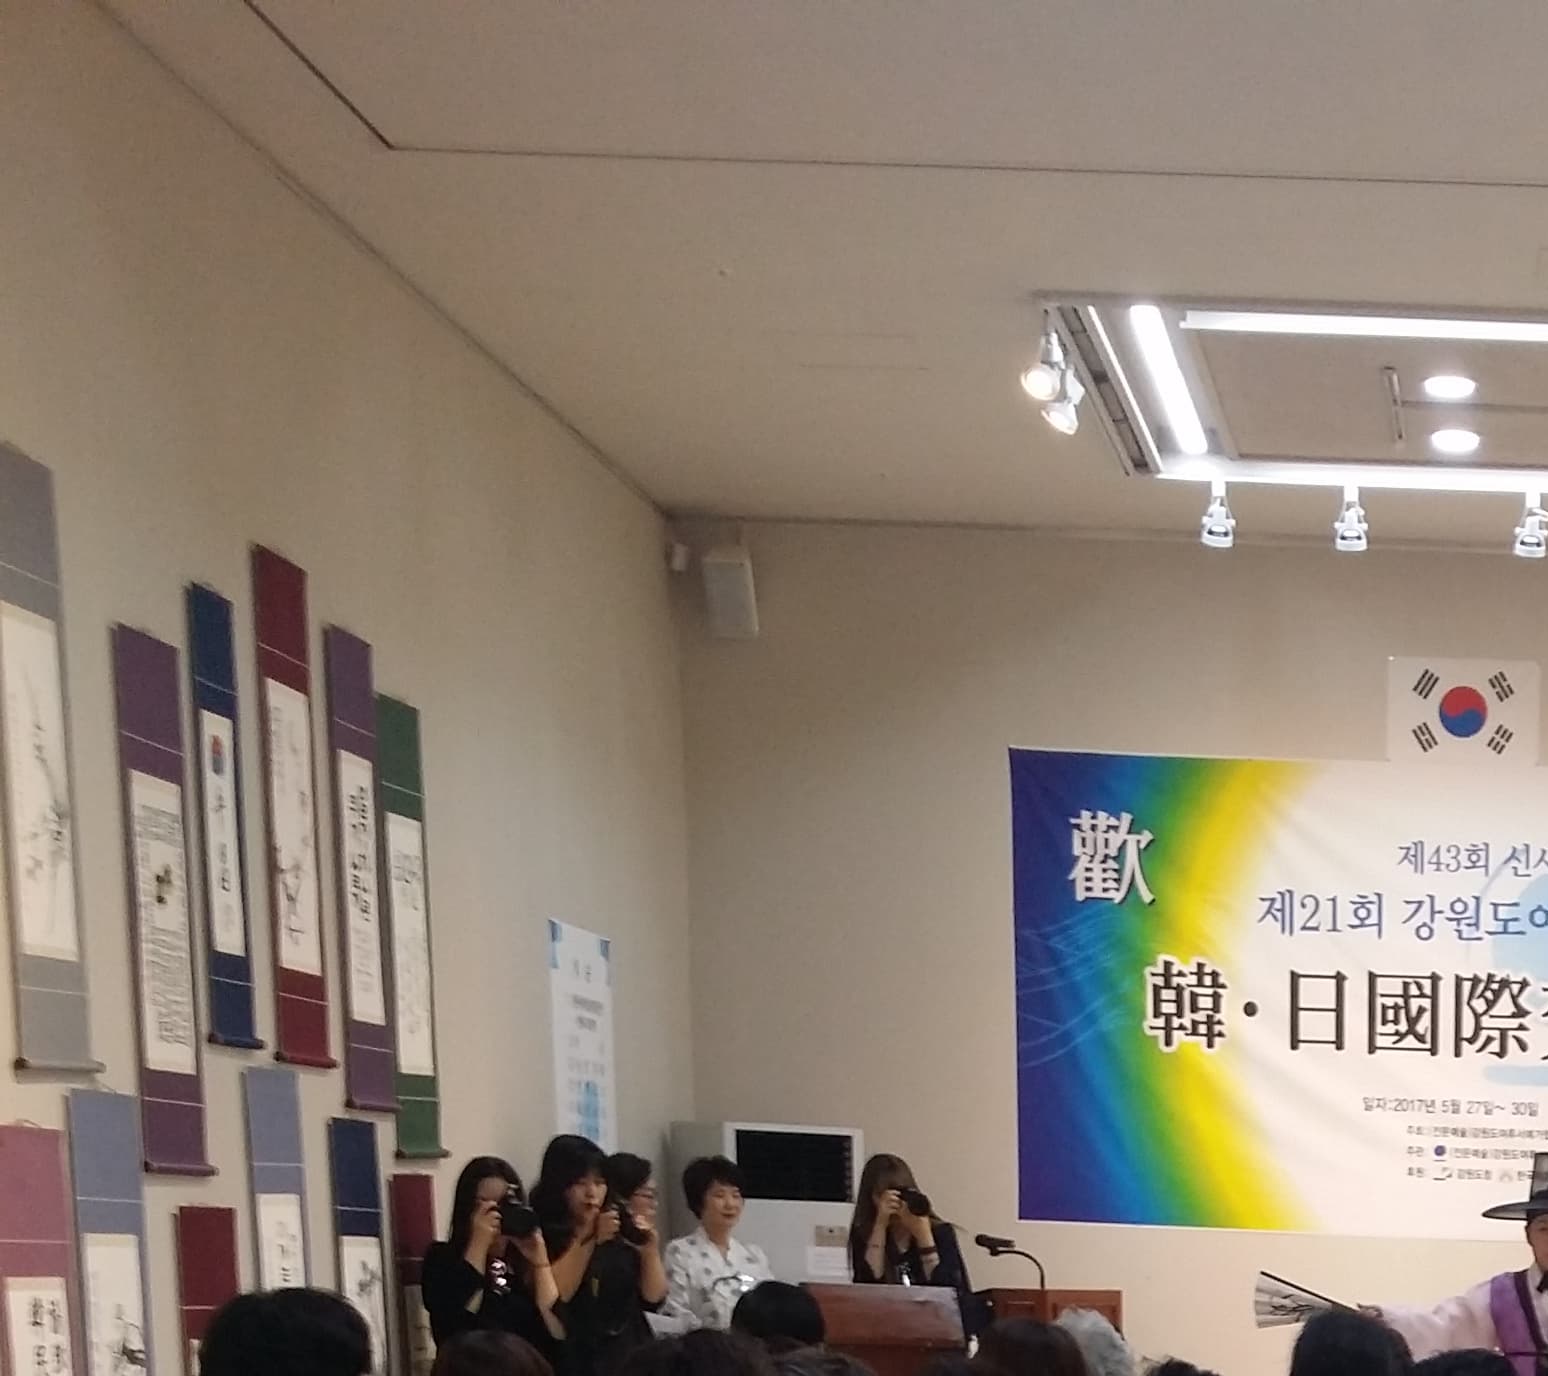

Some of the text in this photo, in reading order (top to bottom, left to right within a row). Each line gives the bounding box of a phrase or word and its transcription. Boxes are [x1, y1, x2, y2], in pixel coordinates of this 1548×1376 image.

[1067, 809, 1156, 906] 歡
[1397, 840, 1490, 877] 제43회
[1257, 888, 1384, 940] 제21회
[1362, 1096, 1436, 1114] 일자:2017년
[1441, 1099, 1462, 1115] 5월
[1511, 1101, 1539, 1117] 30일
